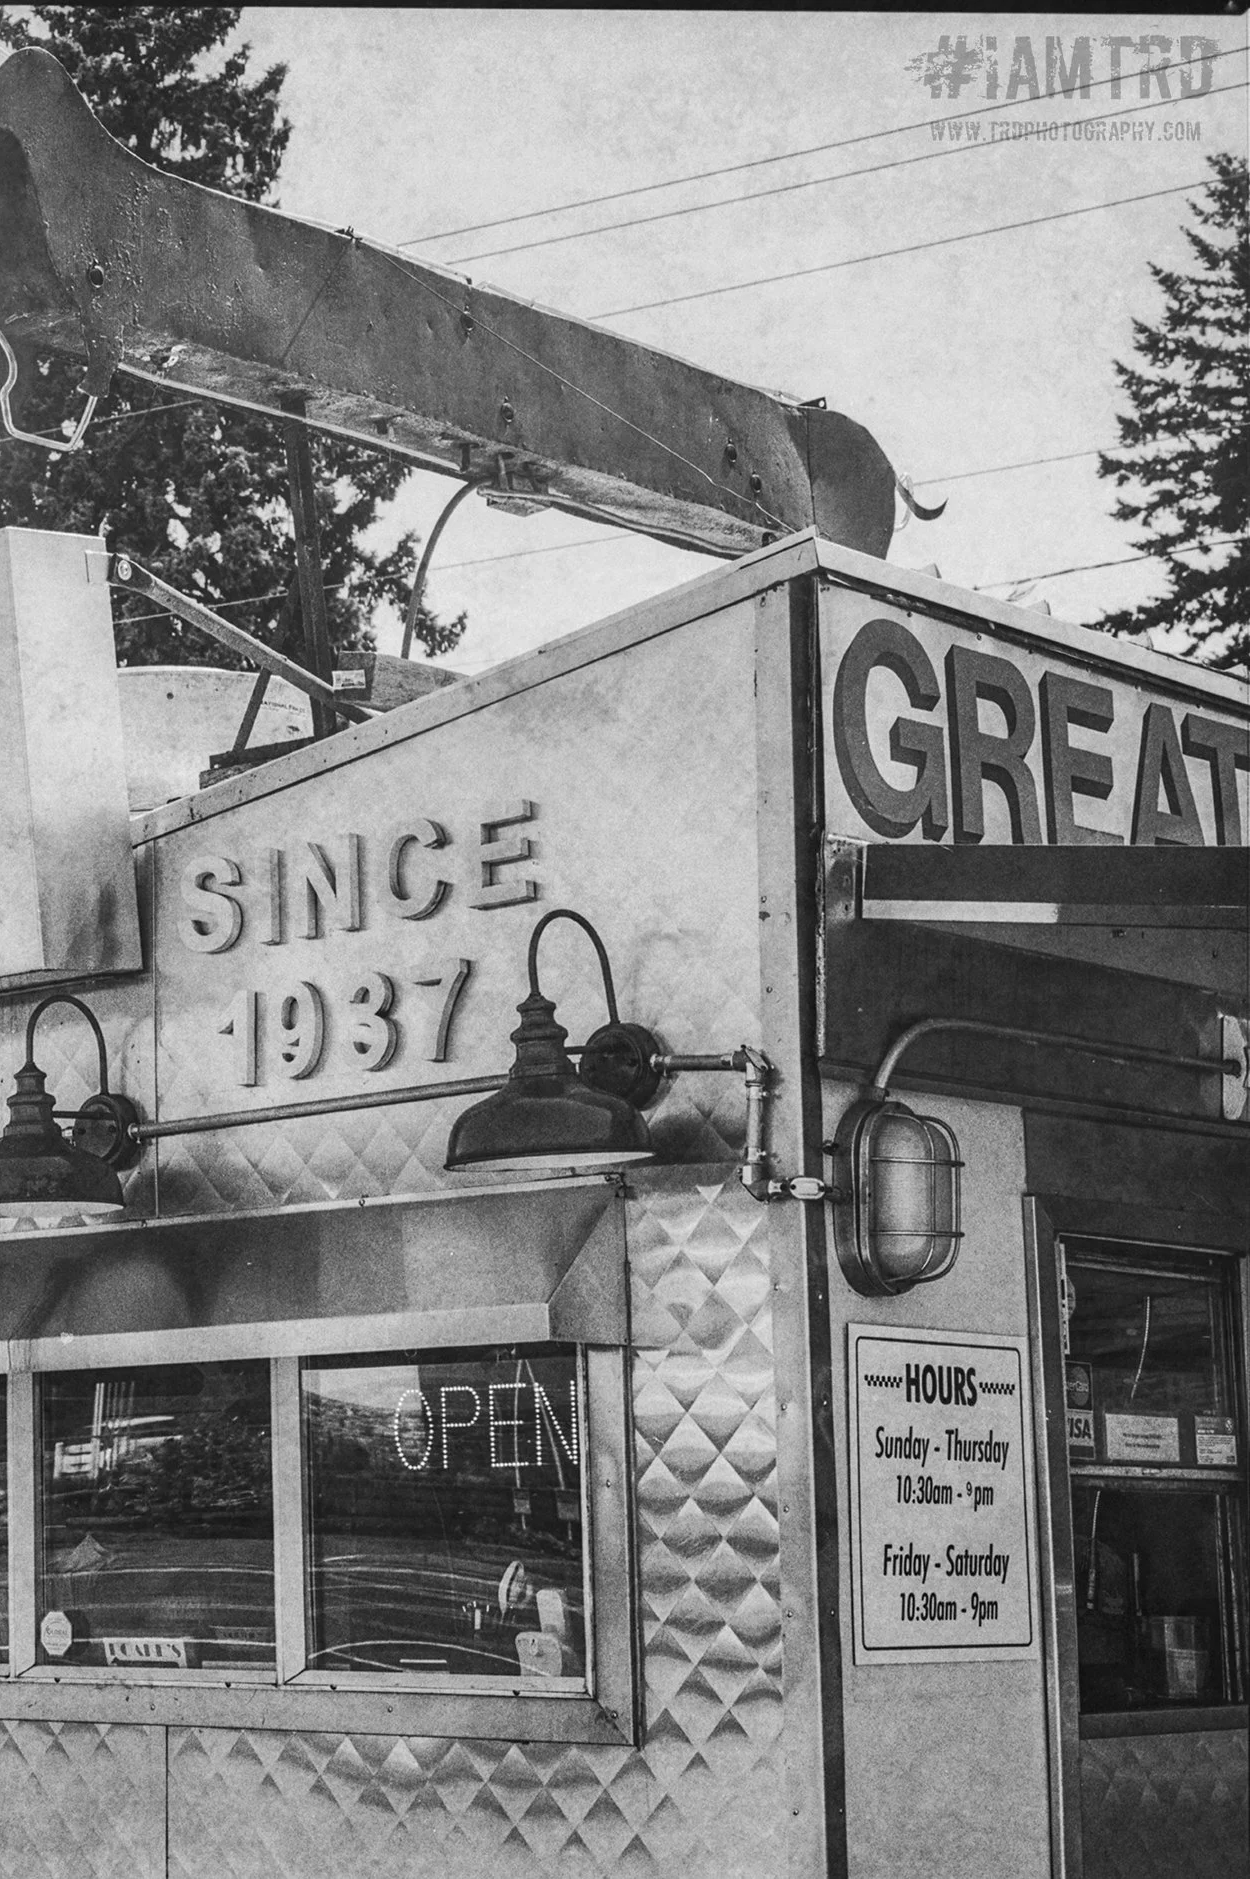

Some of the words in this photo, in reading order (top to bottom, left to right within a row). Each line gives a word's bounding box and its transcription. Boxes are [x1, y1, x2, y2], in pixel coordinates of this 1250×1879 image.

[833, 618, 1250, 846] GREAT
[177, 799, 540, 955] SINCE
[216, 958, 475, 1088] 1937
[905, 1363, 978, 1407] HOURS
[395, 1379, 579, 1471] OPEN
[875, 1426, 930, 1468] Sunday
[945, 1428, 1009, 1470] Thursday
[896, 1475, 953, 1504] 10:30am
[883, 1542, 931, 1584] Friday
[945, 1543, 1010, 1584] Saturday
[900, 1592, 957, 1621] 10:30am
[971, 1592, 999, 1627] 9pm
